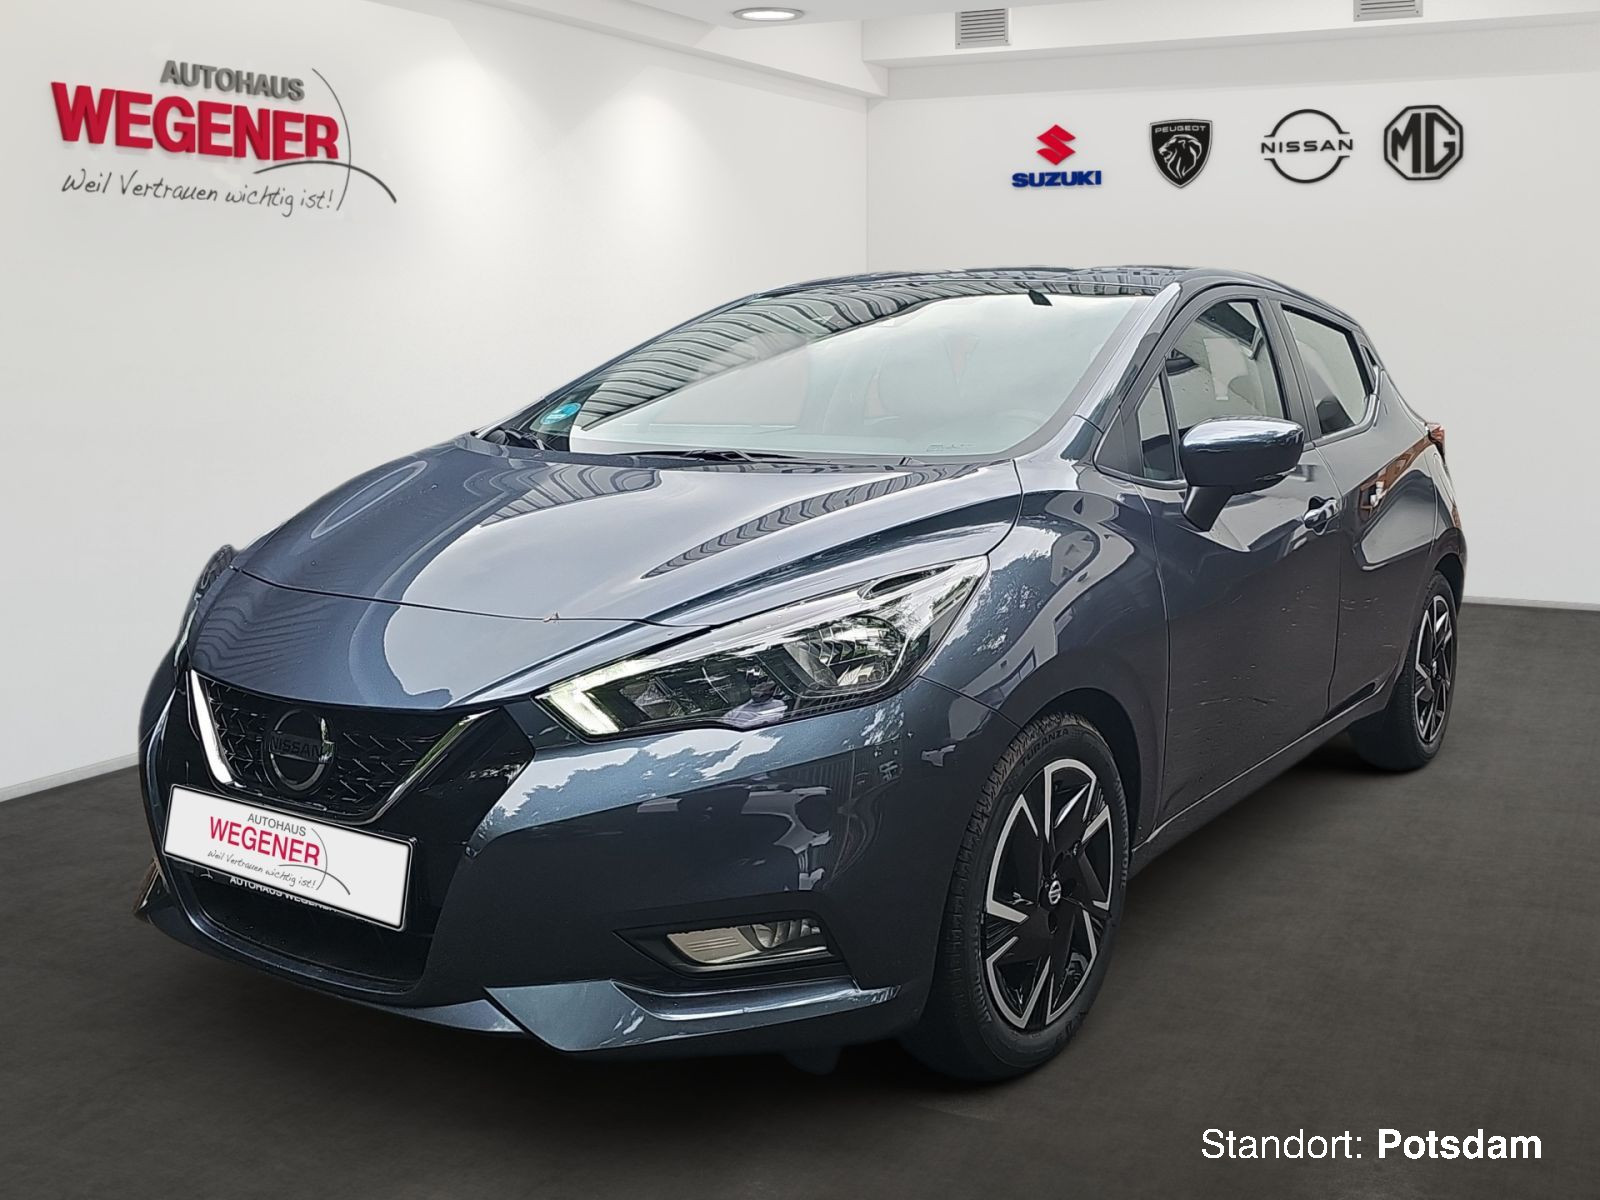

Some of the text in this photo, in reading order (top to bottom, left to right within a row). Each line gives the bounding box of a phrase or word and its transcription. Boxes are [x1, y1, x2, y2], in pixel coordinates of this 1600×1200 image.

[160, 60, 305, 101] AUTOHAUS
[51, 82, 339, 161] WEGENER
[1154, 125, 1207, 134] PEUGEOT
[1261, 138, 1354, 154] NISSAN
[1391, 111, 1457, 175] MG
[62, 168, 112, 193] Weil
[120, 170, 218, 202] Vertrauen
[225, 184, 294, 217] wichtig
[1012, 170, 1102, 188] SUZUKI
[271, 735, 321, 760] NISSAN
[1020, 728, 1070, 767] TURANZA
[210, 816, 320, 866] WEGENER
[247, 813, 307, 837] AUTOHAUS
[207, 849, 225, 861] Weil
[226, 853, 264, 874] Vertrauen
[265, 866, 297, 888] wichtig
